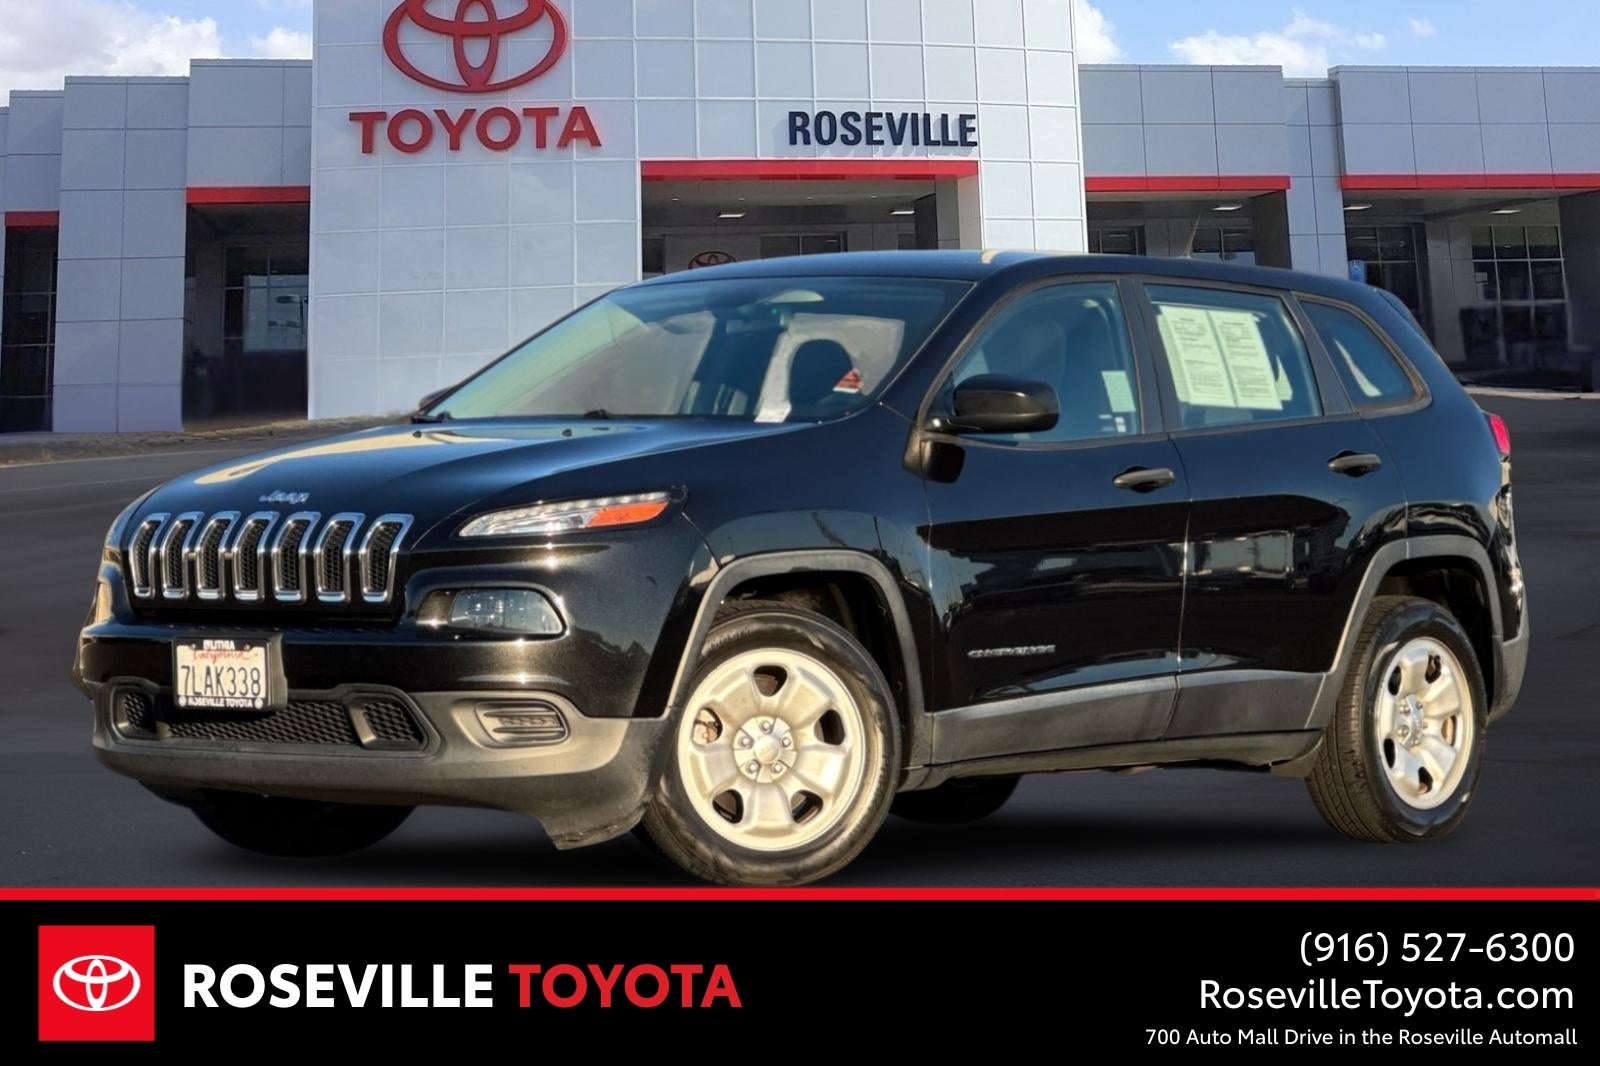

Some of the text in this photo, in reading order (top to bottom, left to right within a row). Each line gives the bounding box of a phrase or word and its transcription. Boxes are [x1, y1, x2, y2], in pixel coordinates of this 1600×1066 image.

[349, 106, 602, 154] TOYOTA
[788, 110, 978, 147] ROSEVILLE
[180, 664, 262, 697] 7LAK338
[187, 697, 254, 708] ROSEVILLE TOYOTA
